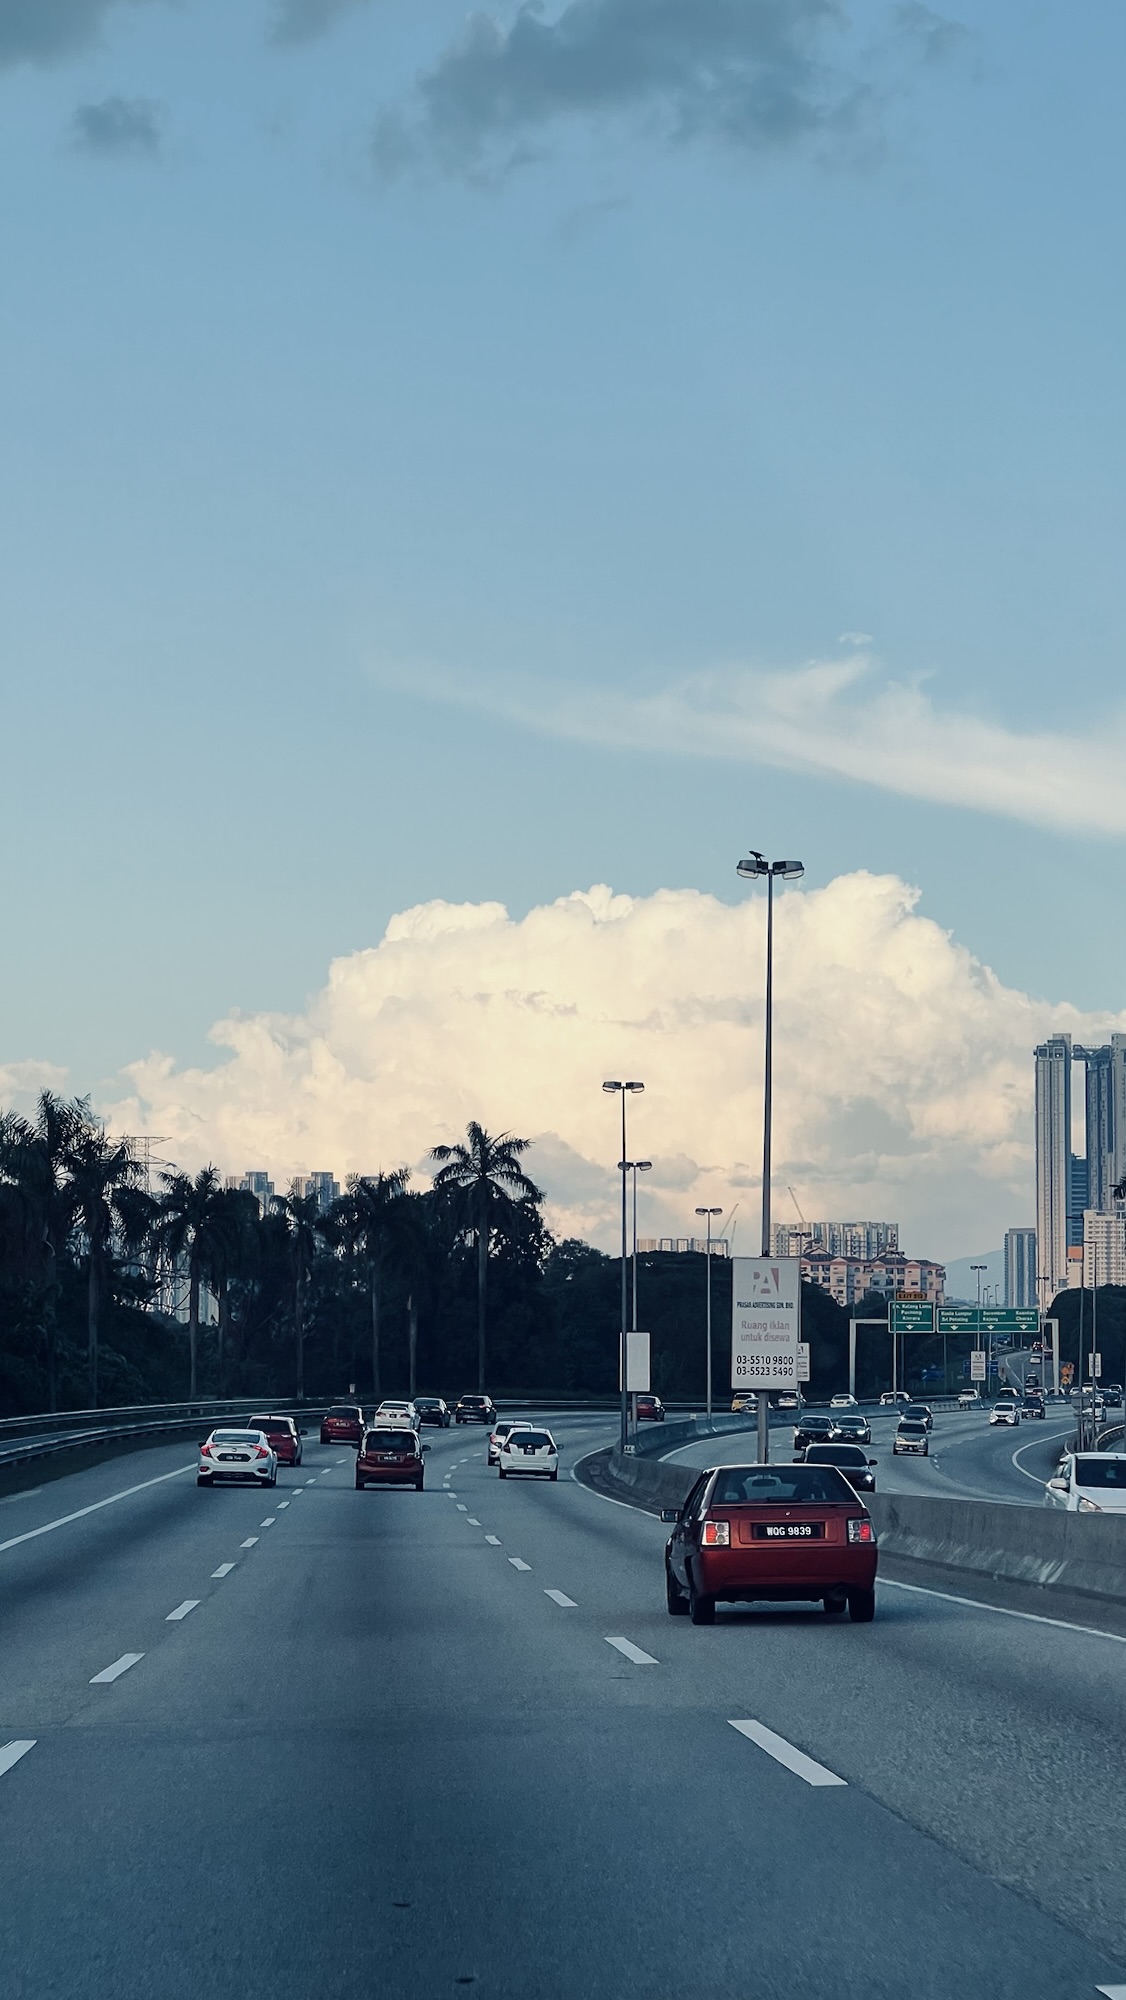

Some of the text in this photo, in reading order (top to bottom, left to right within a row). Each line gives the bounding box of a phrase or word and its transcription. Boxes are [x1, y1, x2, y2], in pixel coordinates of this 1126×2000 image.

[752, 1301, 776, 1309] ADVERTISING
[741, 1320, 790, 1332] Ruang iklan
[740, 1332, 790, 1342] untuk disewa
[736, 1355, 794, 1365] 03-5510 9800
[736, 1366, 770, 1376] 03-5523
[772, 1367, 794, 1376] 5490
[766, 1526, 812, 1536] WQG 9839
